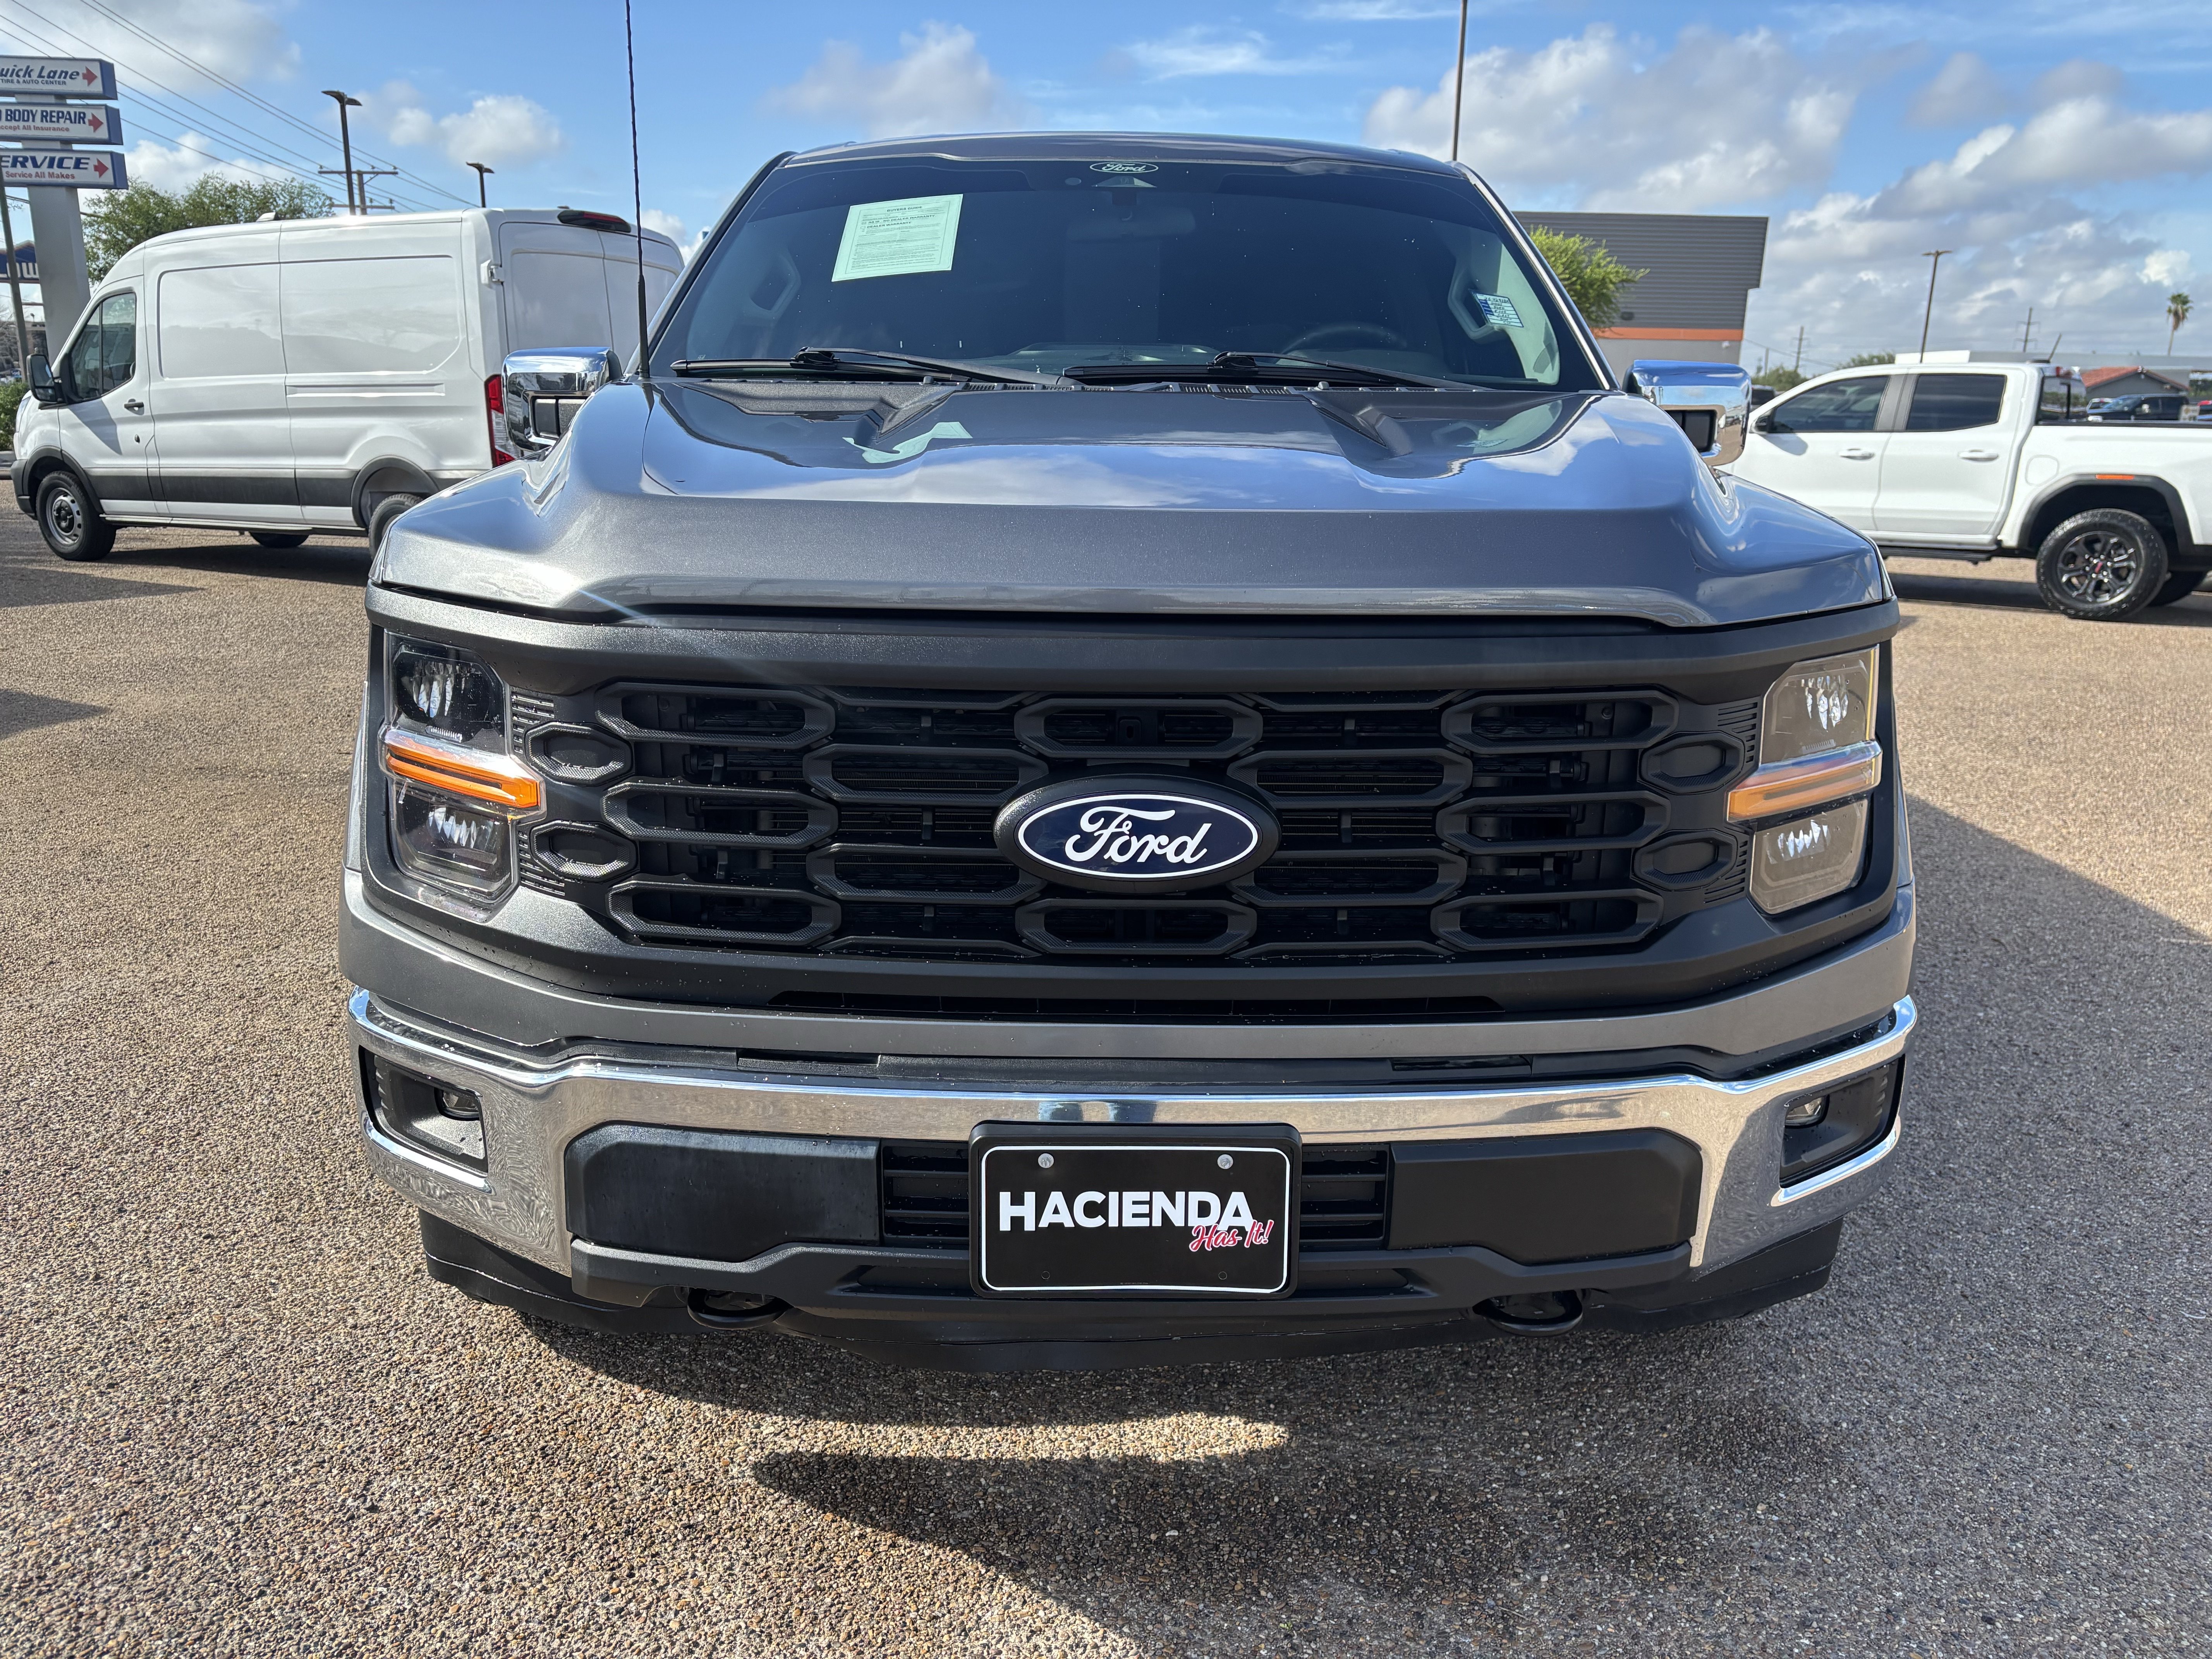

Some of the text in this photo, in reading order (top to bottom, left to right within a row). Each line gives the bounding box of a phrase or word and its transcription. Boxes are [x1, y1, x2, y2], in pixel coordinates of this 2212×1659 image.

[0, 65, 80, 80] uick Lane
[5, 109, 38, 122] BODY
[40, 110, 86, 124] REPAIR
[0, 155, 90, 170] ERVICE
[1102, 162, 1146, 172] Ford
[1065, 806, 1212, 864] Ford
[1000, 1191, 1253, 1231] HACIENDA
[1188, 1220, 1274, 1252] Has It!
